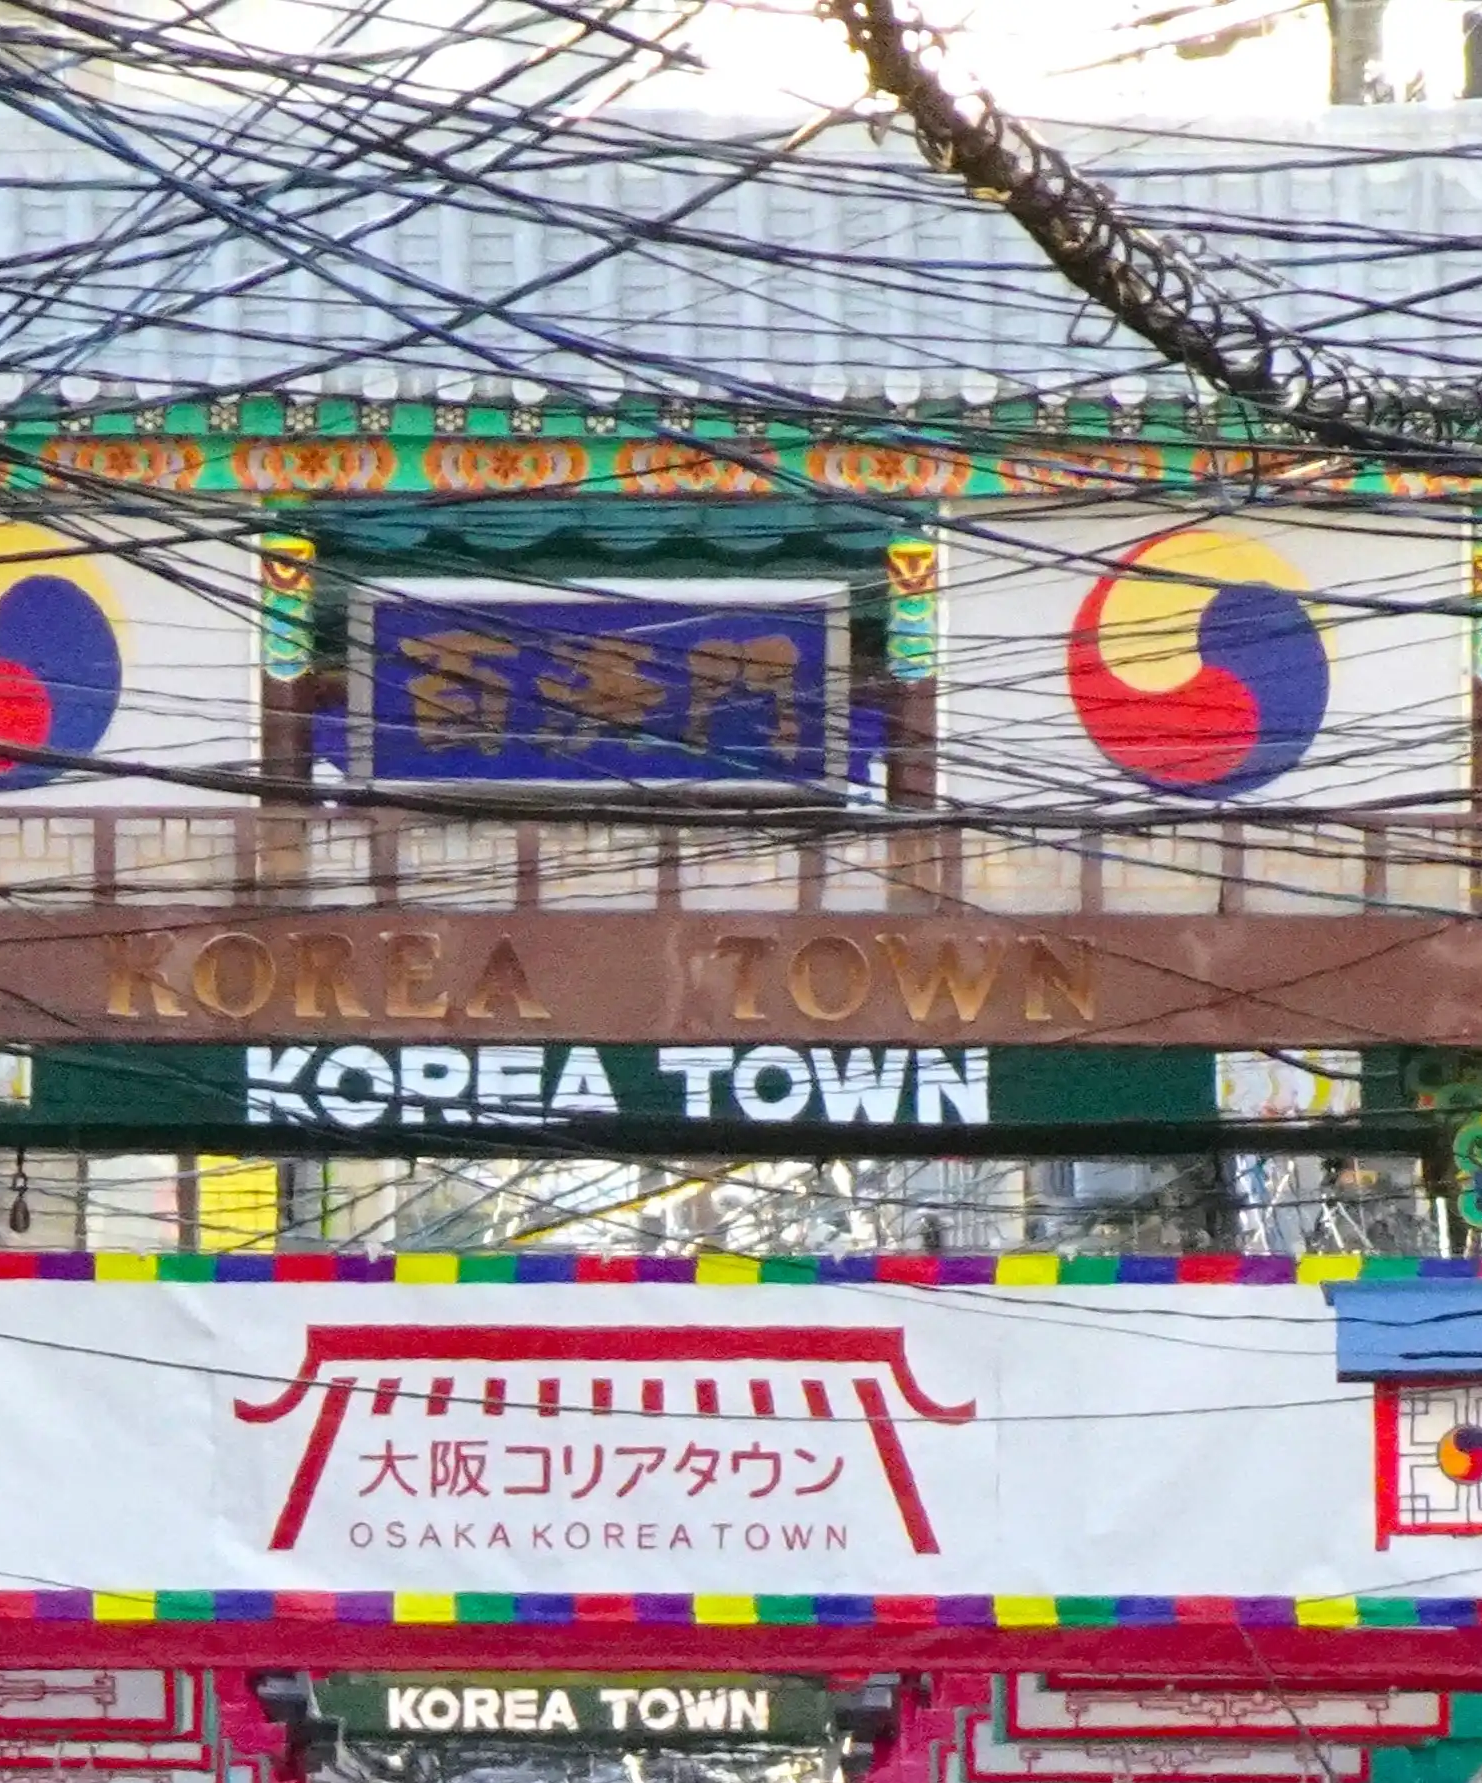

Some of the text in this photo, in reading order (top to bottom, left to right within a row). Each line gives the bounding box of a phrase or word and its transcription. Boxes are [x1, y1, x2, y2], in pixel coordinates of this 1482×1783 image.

[108, 930, 1096, 1023] KOREA TOWN
[244, 1045, 990, 1126] KOREA TOWN
[359, 1439, 844, 1498] 大阪コリアタウン
[350, 1521, 848, 1551] OSAKA KOREA TOWN
[387, 1687, 770, 1732] KOREA TOWN
